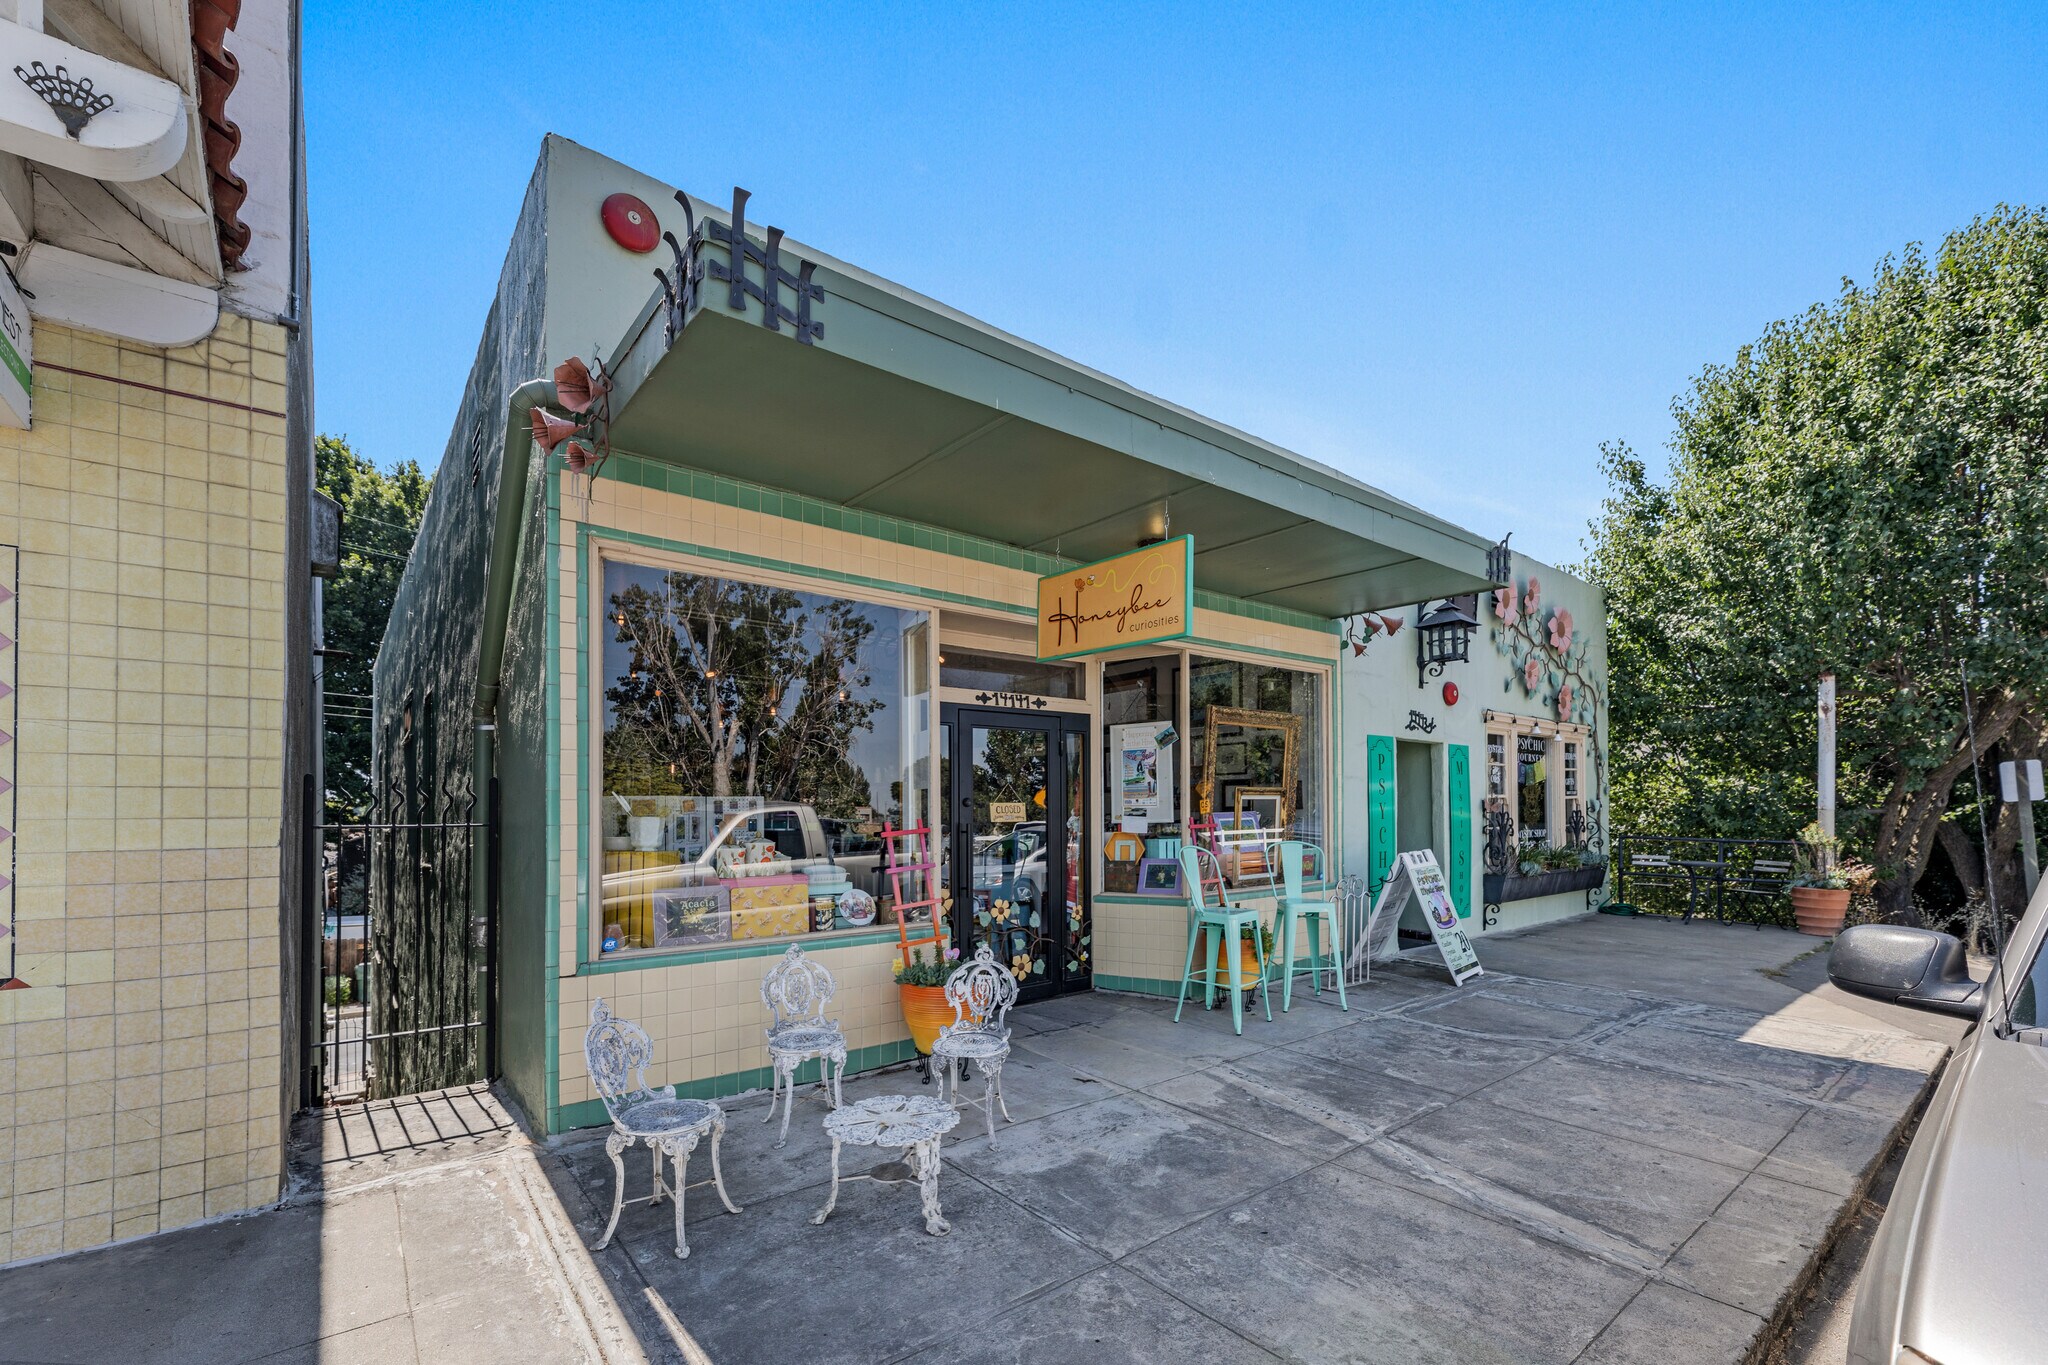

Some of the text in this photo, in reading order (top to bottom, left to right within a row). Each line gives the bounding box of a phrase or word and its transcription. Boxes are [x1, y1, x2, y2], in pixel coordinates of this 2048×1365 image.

[1048, 583, 1172, 646] Honeybee
[1129, 613, 1180, 633] curiosities
[992, 692, 1030, 709] 14141
[1516, 737, 1546, 752] PSYCHIC
[995, 804, 1022, 814] CLOSED
[1456, 761, 1464, 842] MYSTIC
[680, 898, 716, 911] Acacia
